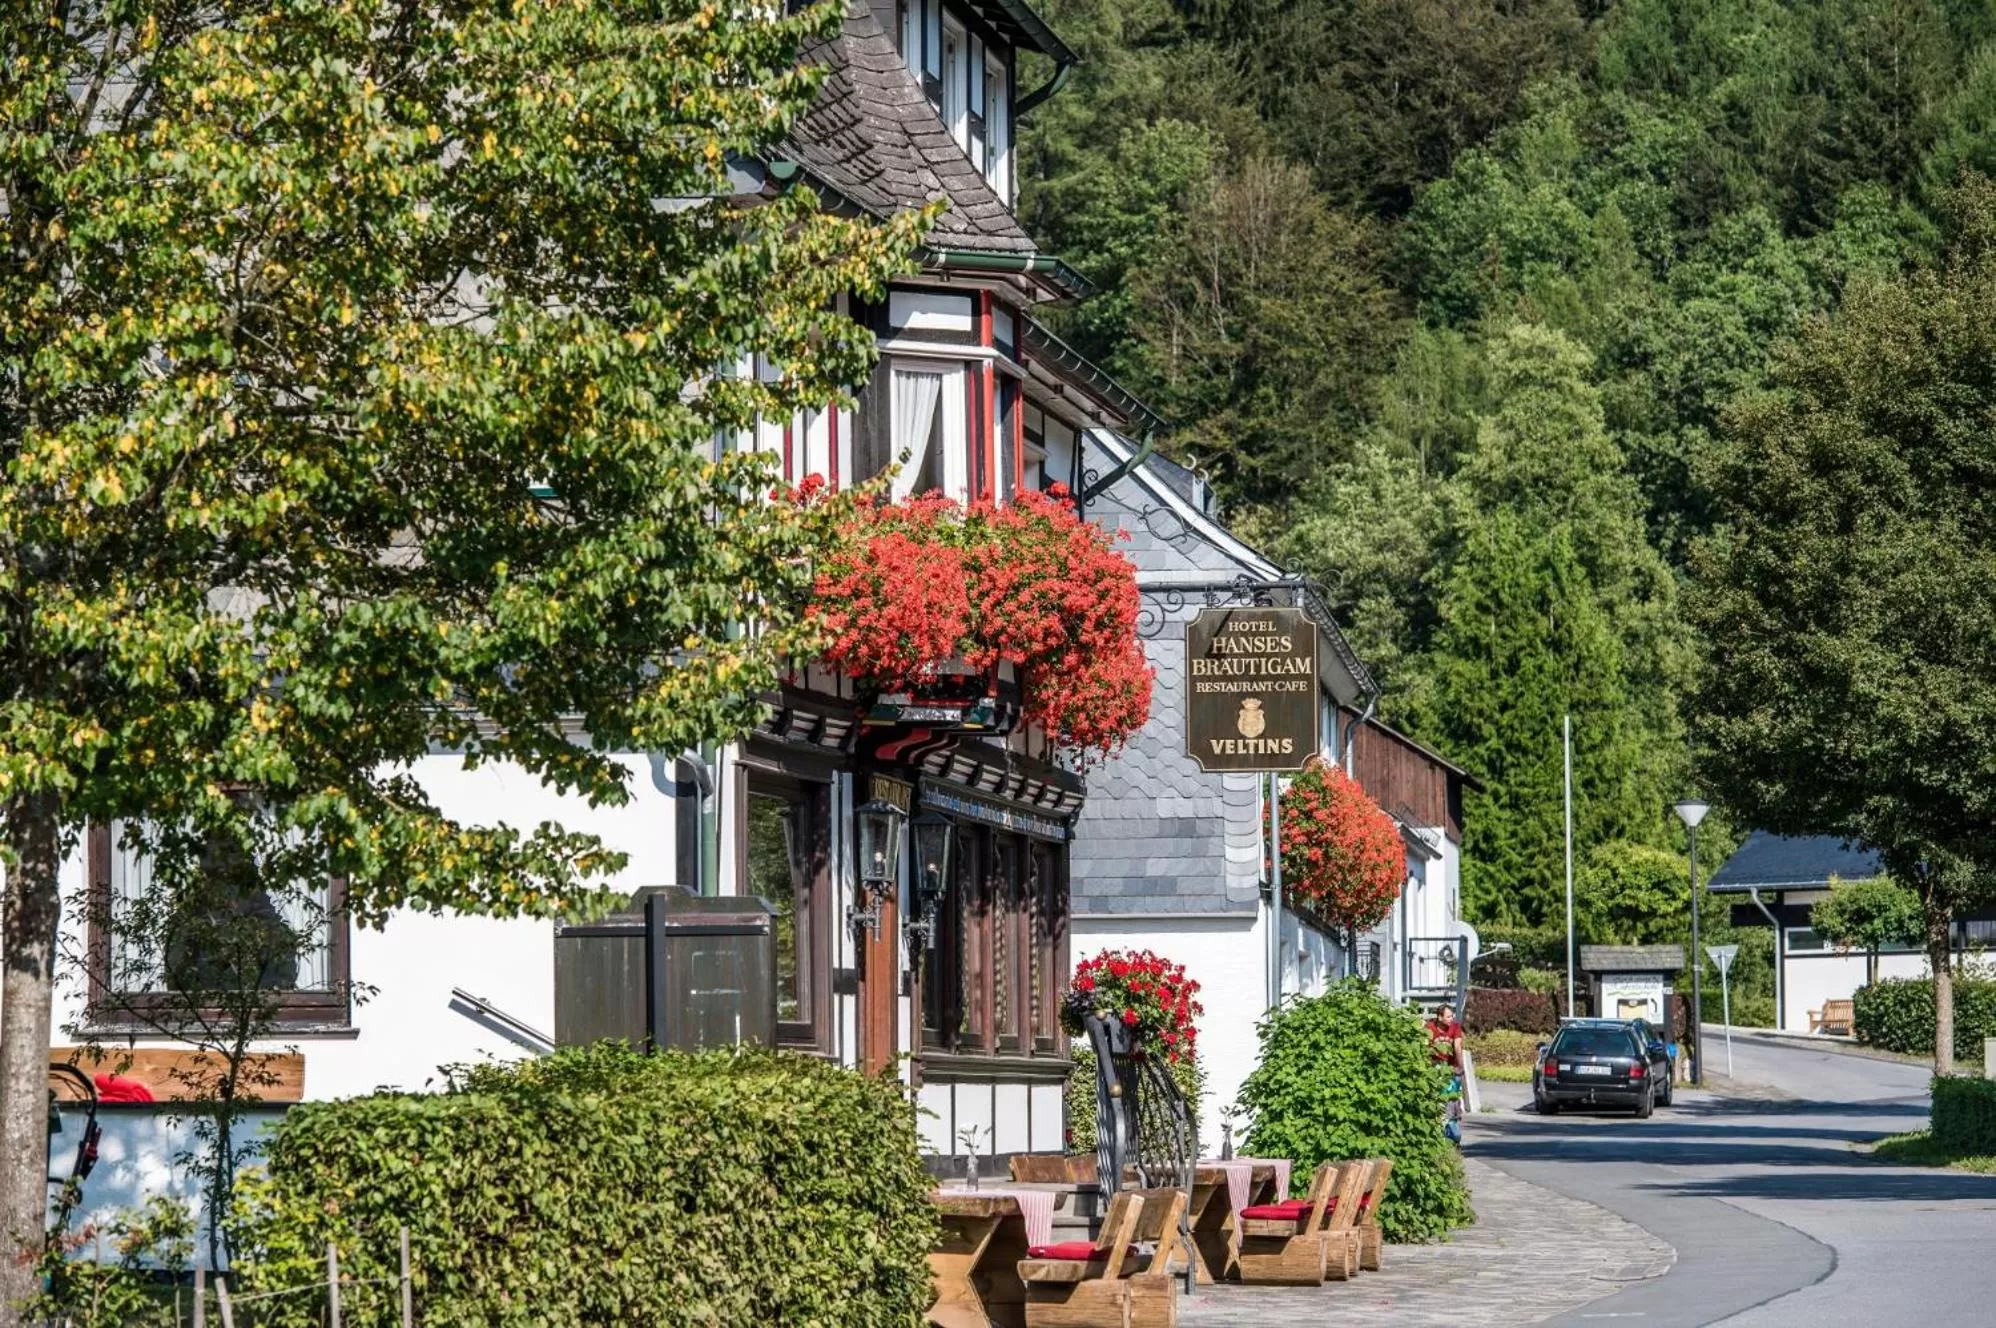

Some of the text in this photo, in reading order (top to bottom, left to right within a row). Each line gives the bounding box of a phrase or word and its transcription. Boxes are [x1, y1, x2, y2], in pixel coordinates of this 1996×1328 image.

[1228, 621, 1277, 632] HOTEL
[1212, 636, 1293, 654] HANSES
[1192, 657, 1312, 676] BRÄUTIGAM
[1210, 738, 1294, 755] VELTINS
